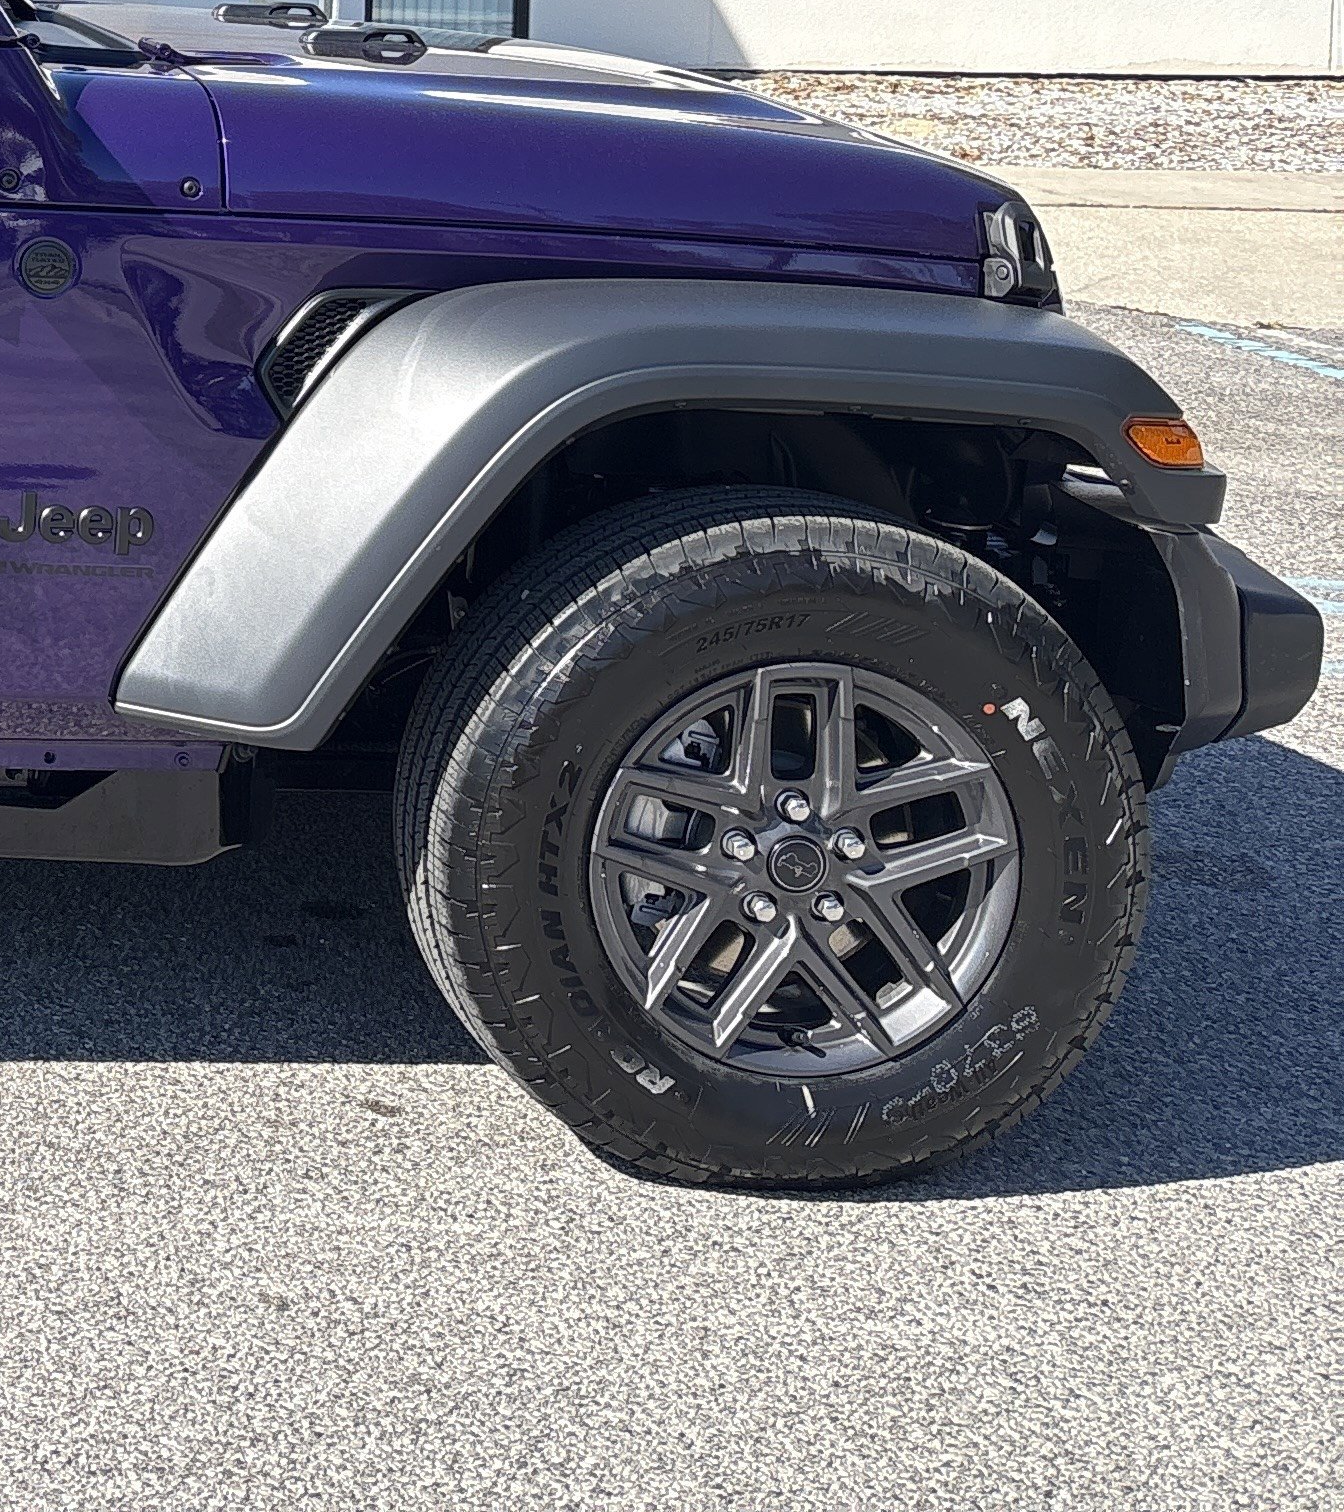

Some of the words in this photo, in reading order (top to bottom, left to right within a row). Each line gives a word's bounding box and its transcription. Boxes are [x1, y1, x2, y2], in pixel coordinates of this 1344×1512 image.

[10, 561, 155, 579] WRANGLER
[695, 613, 812, 654] 245/75R17
[1000, 696, 1089, 925] NEXEN
